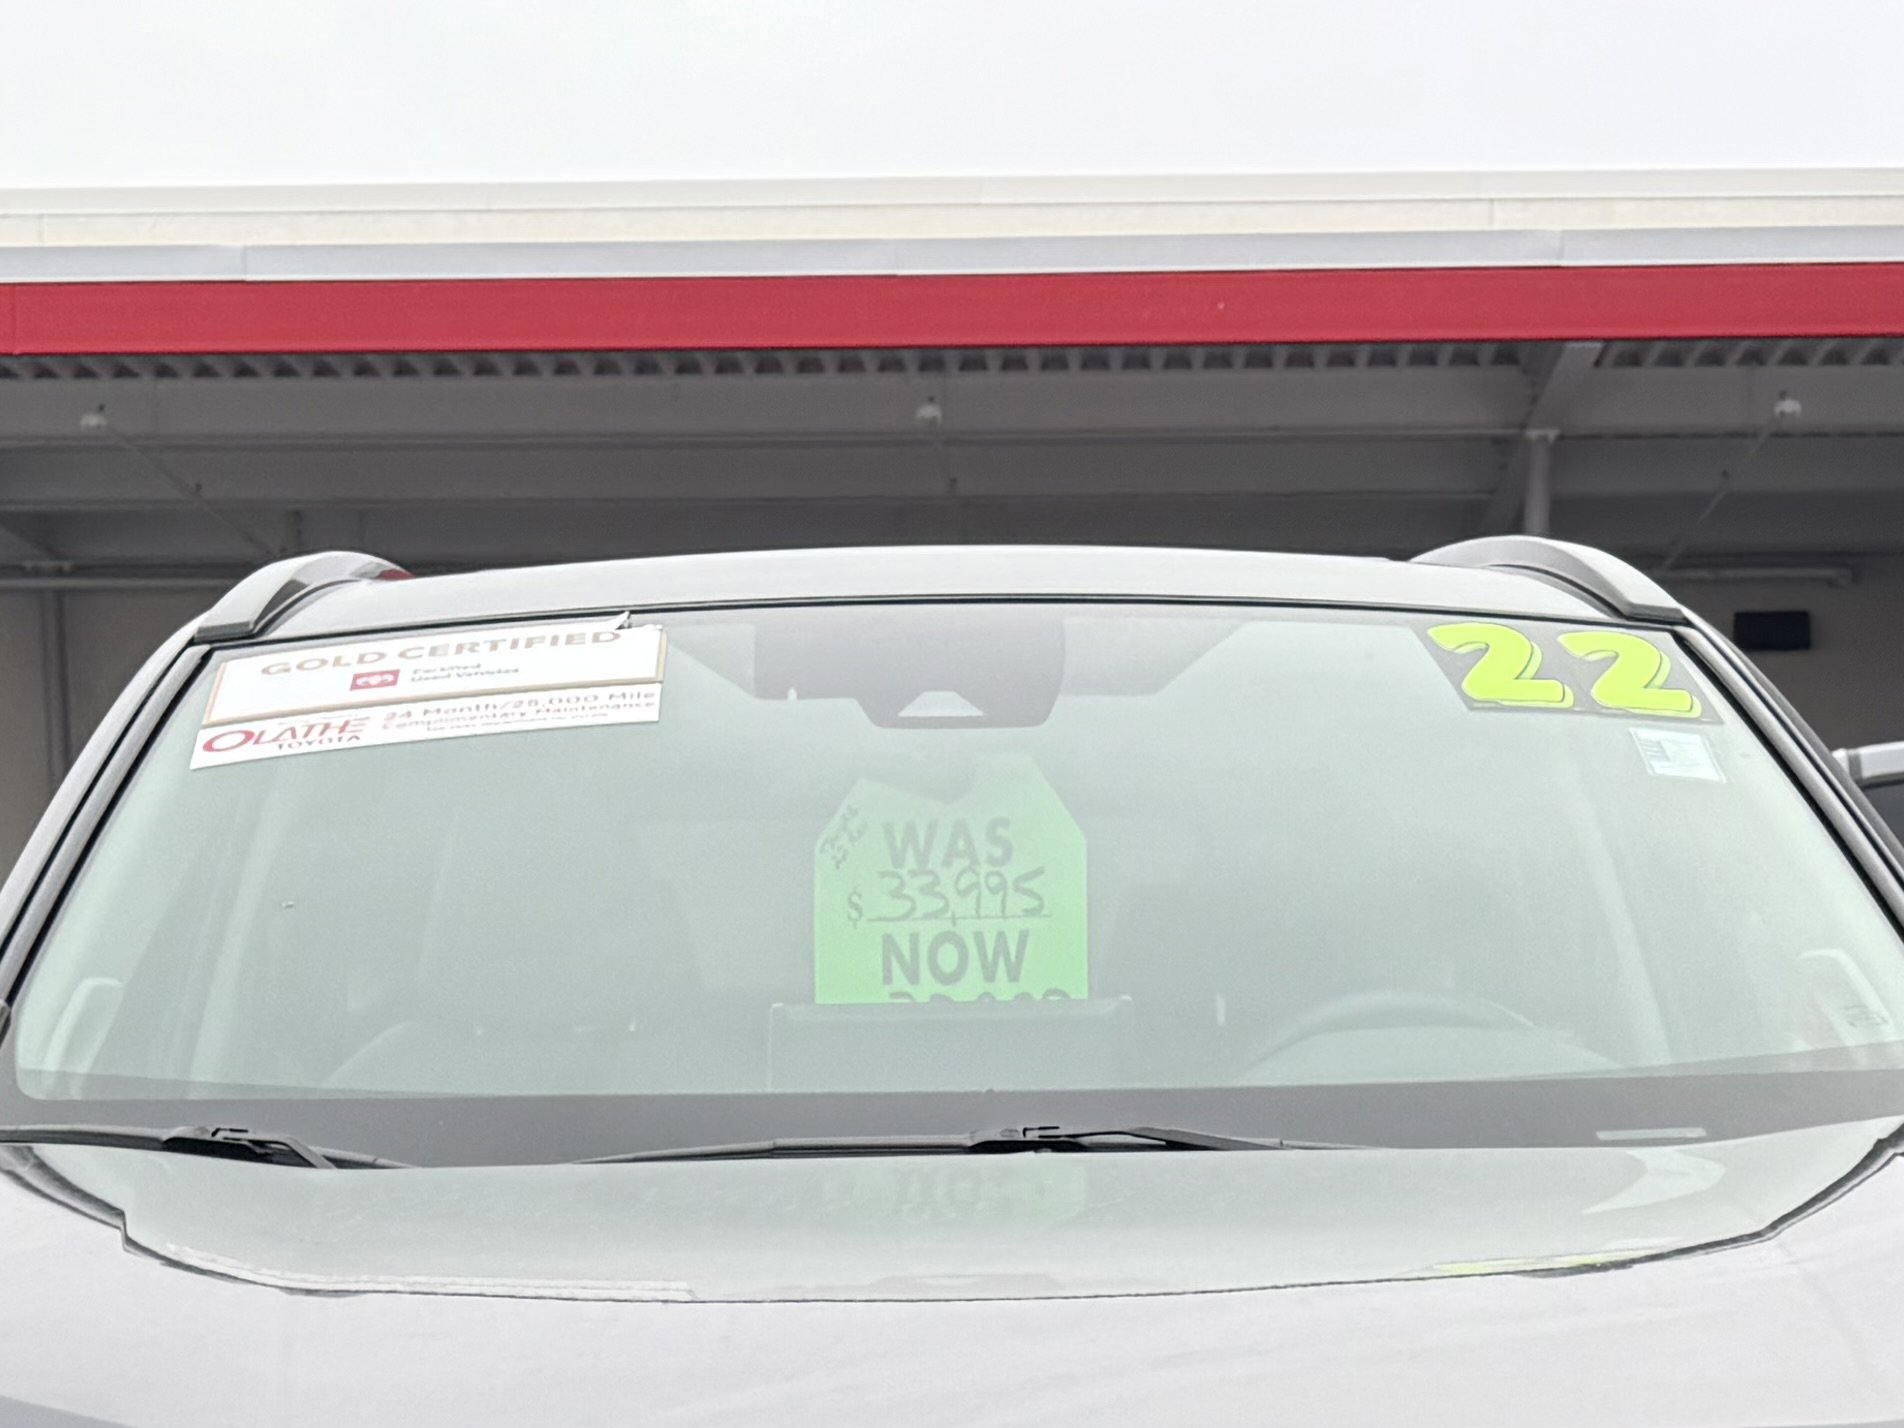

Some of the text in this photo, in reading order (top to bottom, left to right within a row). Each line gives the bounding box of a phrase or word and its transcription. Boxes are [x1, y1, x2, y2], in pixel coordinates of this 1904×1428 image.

[262, 632, 621, 674] GOLD CERTIFIED
[1427, 622, 1703, 718] 22
[608, 691, 655, 700] Mile
[202, 716, 371, 752] OLATHE
[277, 735, 361, 751] TOYOTA
[881, 816, 1015, 869] WAS
[881, 928, 1031, 986] NOW
